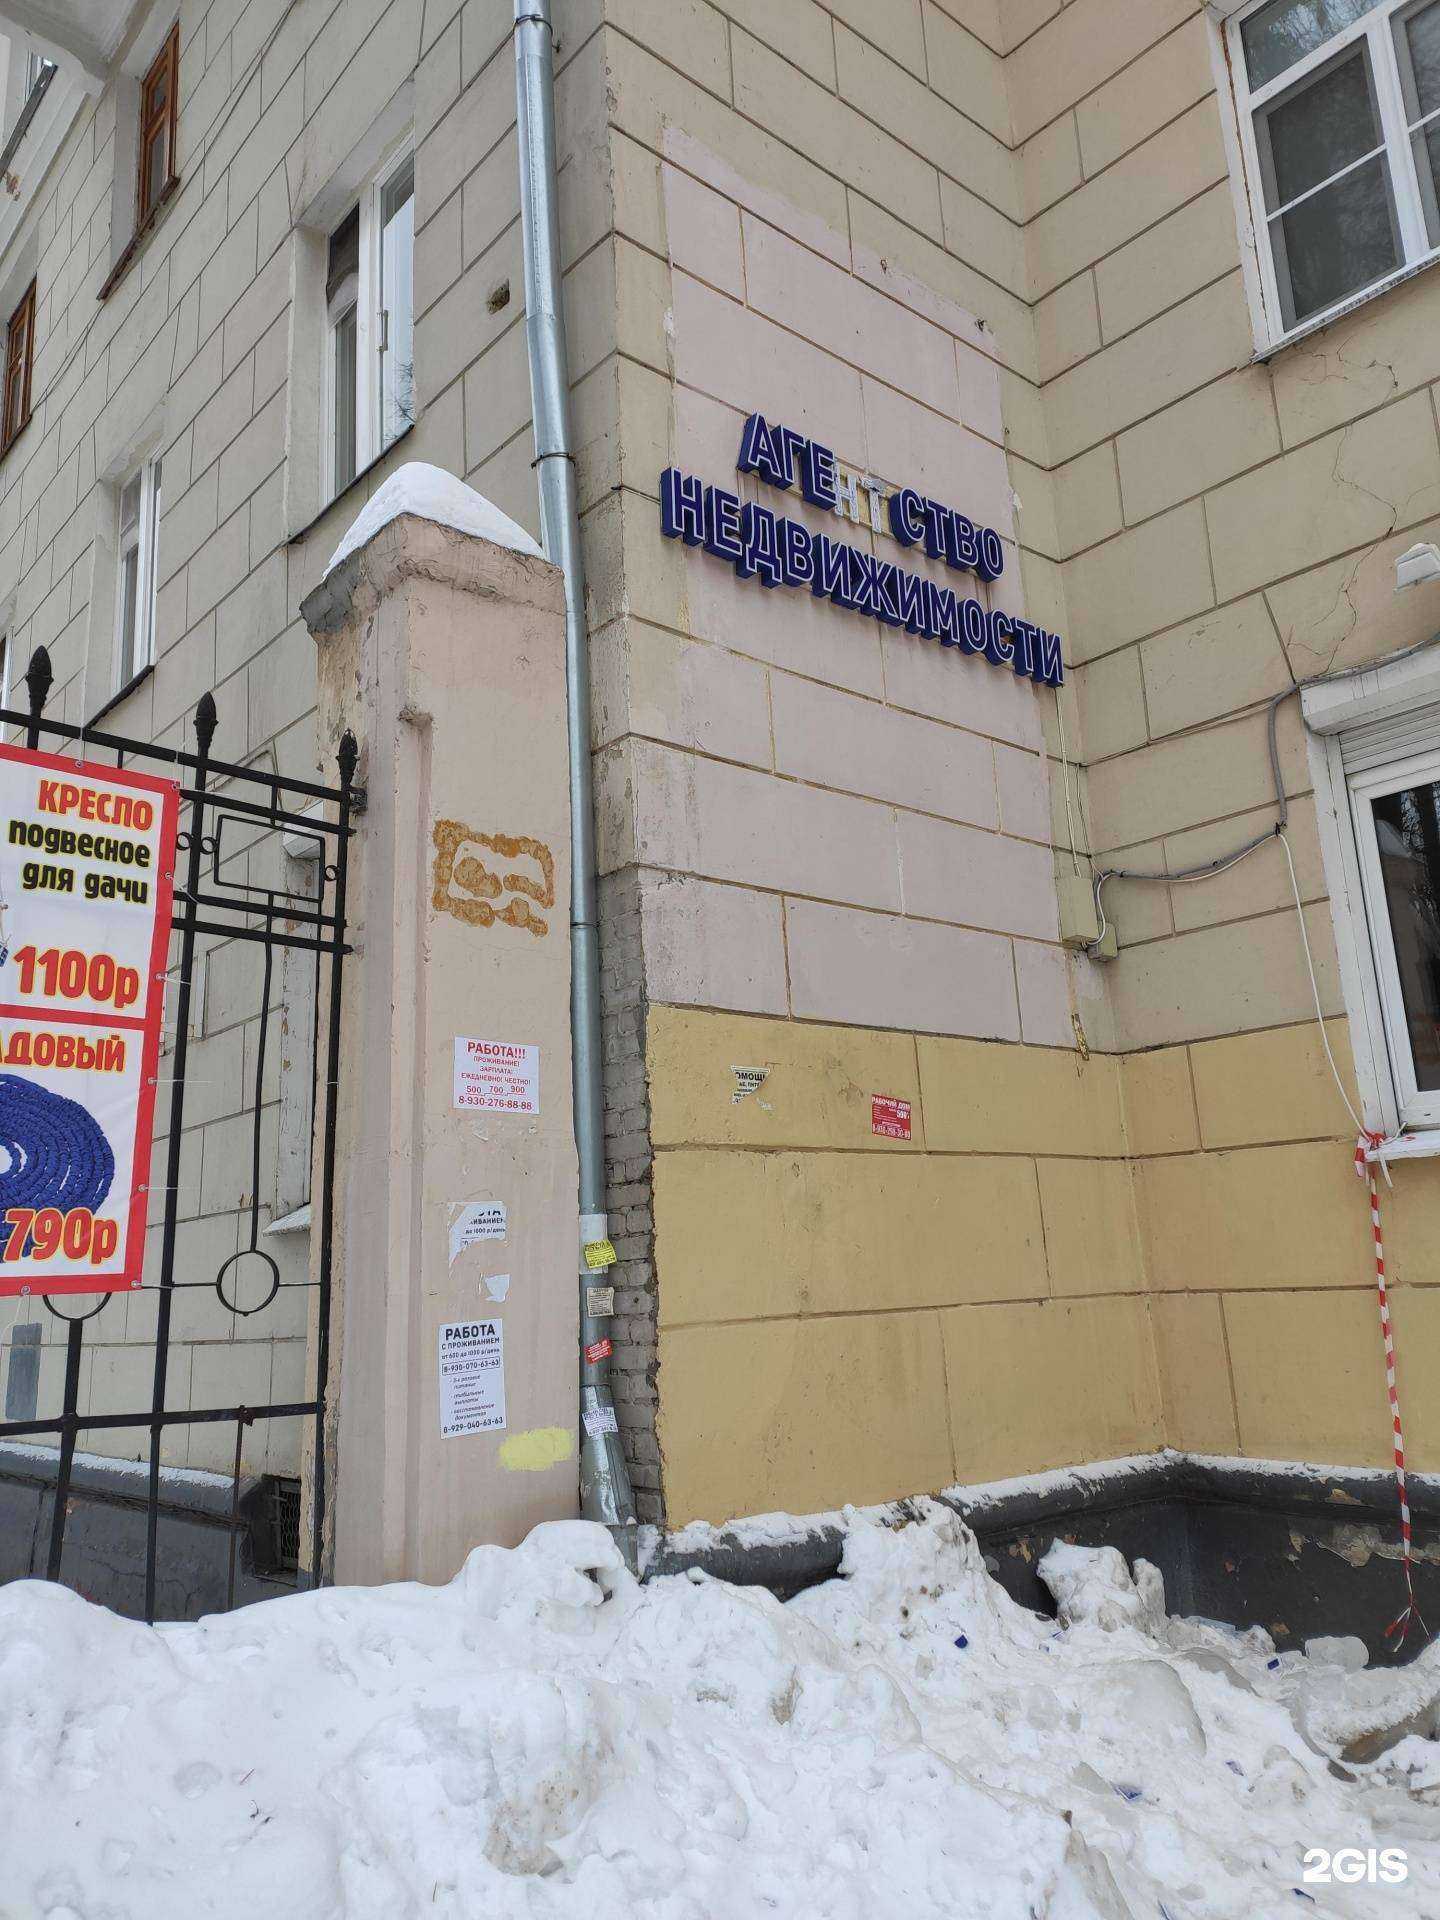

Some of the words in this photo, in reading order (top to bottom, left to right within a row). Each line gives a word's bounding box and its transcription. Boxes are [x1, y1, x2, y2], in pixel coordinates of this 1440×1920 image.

[738, 412, 1004, 583] АГЕНТСТВО
[660, 466, 1064, 688] НЕДВИЖИМОСТИ
[38, 779, 154, 831] КРЕСЛО
[9, 819, 151, 868] подвесное
[23, 862, 74, 892] для
[84, 872, 148, 904] дачи
[13, 945, 140, 1009] 1100р
[0, 1031, 126, 1073] ДОВЫЙ
[467, 1041, 526, 1059] РАБОТА!!!
[4, 1208, 118, 1264] 790р
[445, 1323, 496, 1341] РАБОТА
[447, 1336, 500, 1349] ПРОЖИВАНИЕМ
